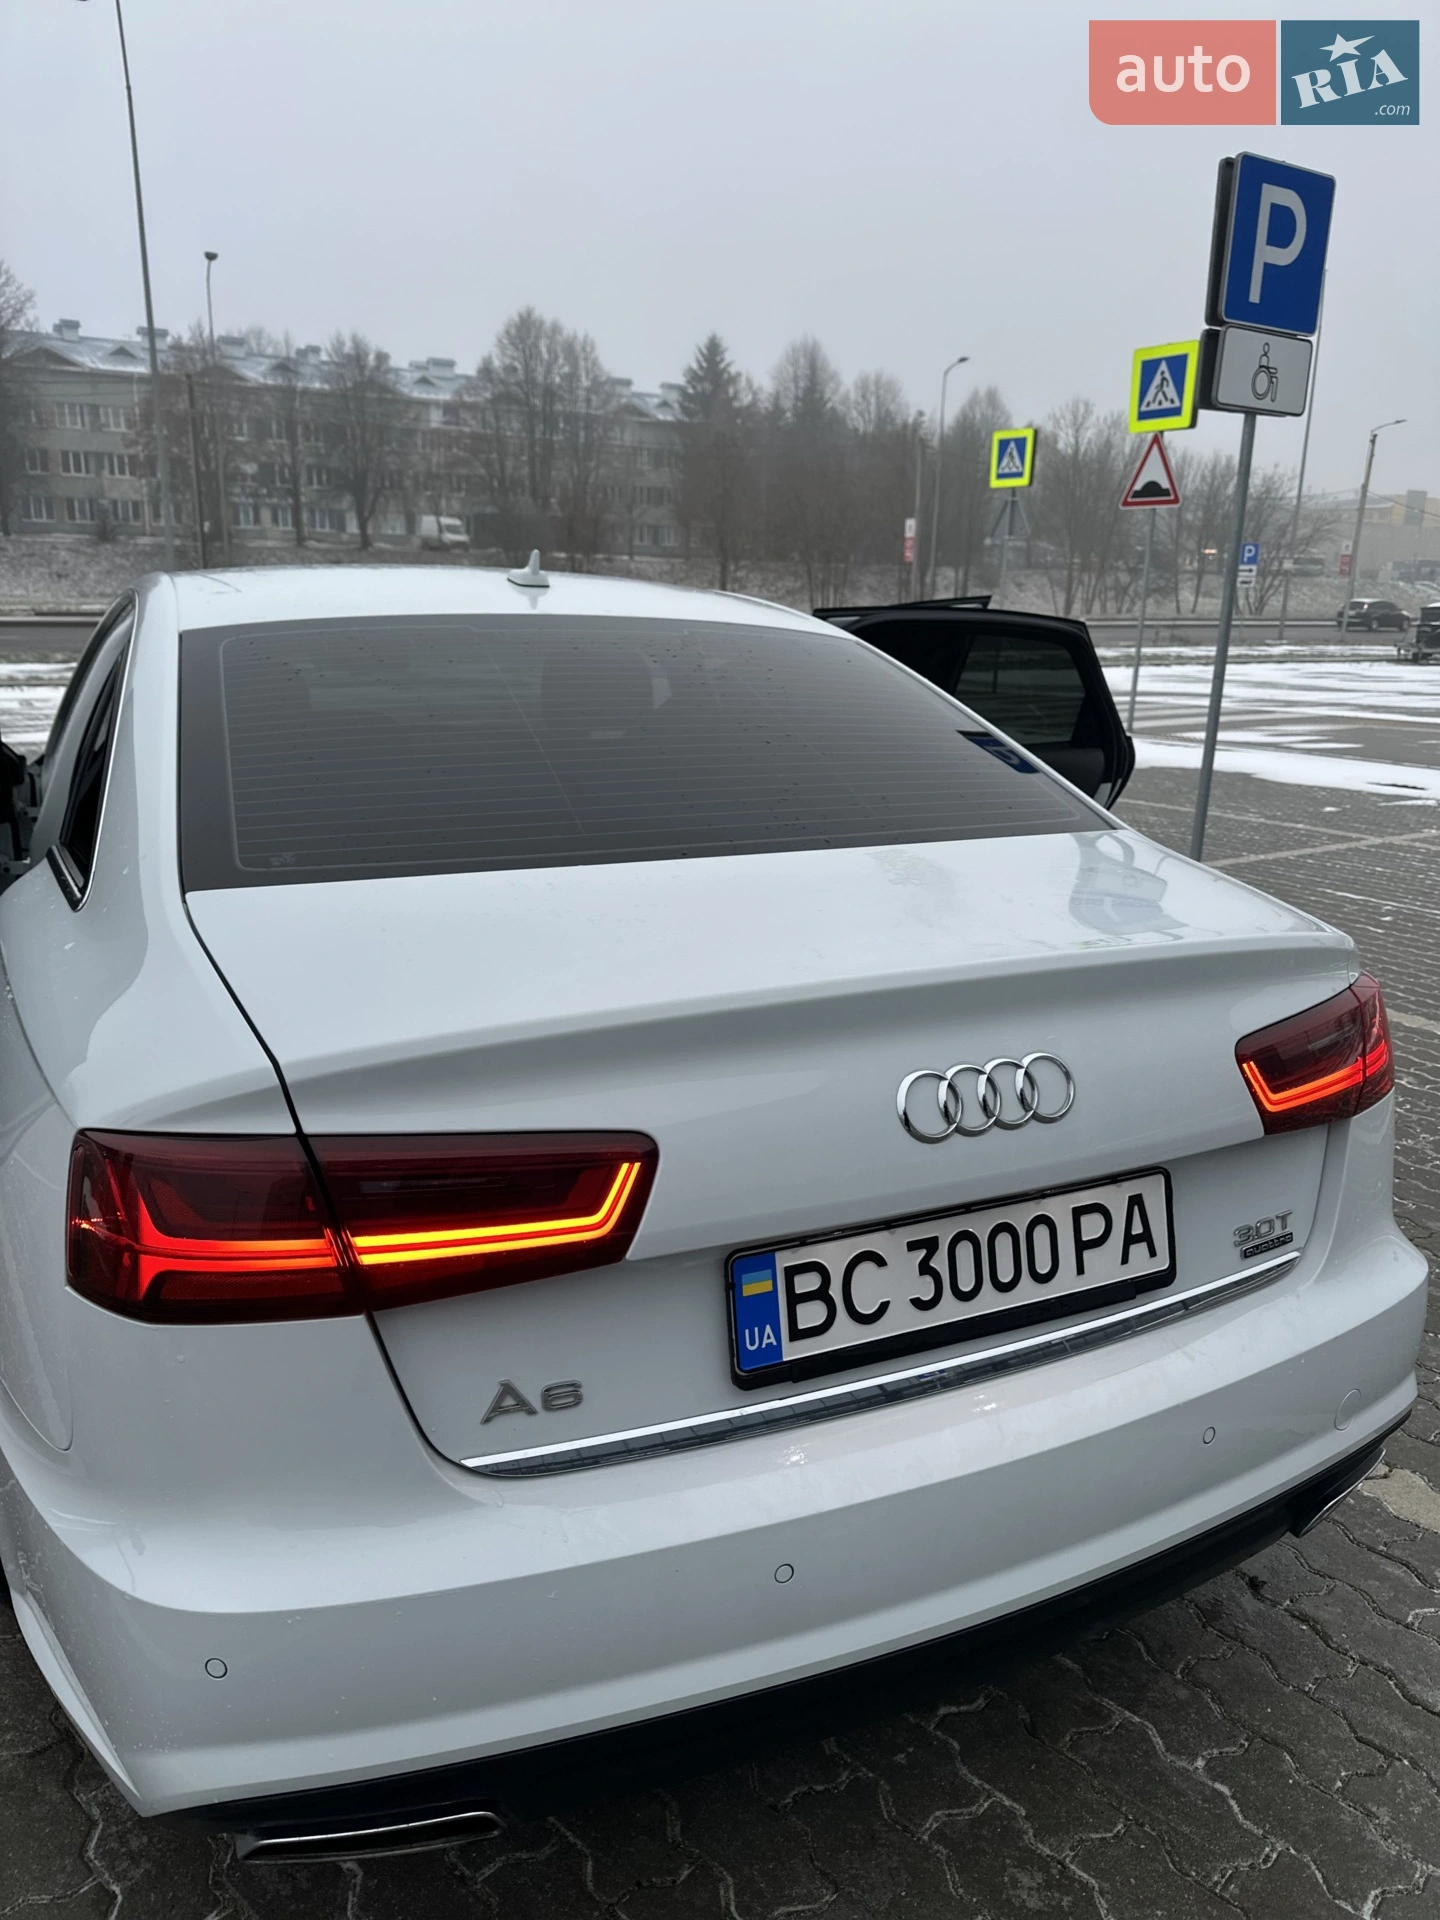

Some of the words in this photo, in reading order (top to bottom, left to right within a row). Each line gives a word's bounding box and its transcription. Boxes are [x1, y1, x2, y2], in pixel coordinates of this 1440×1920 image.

[1248, 182, 1307, 304] P
[1243, 545, 1256, 563] P
[1233, 1209, 1293, 1248] 3.0T
[1245, 1233, 1293, 1257] quattro
[783, 1249, 891, 1343] BC
[906, 1213, 1060, 1312] 3000
[1071, 1192, 1157, 1276] PA
[745, 1324, 777, 1351] UA
[480, 1379, 584, 1425] A6
